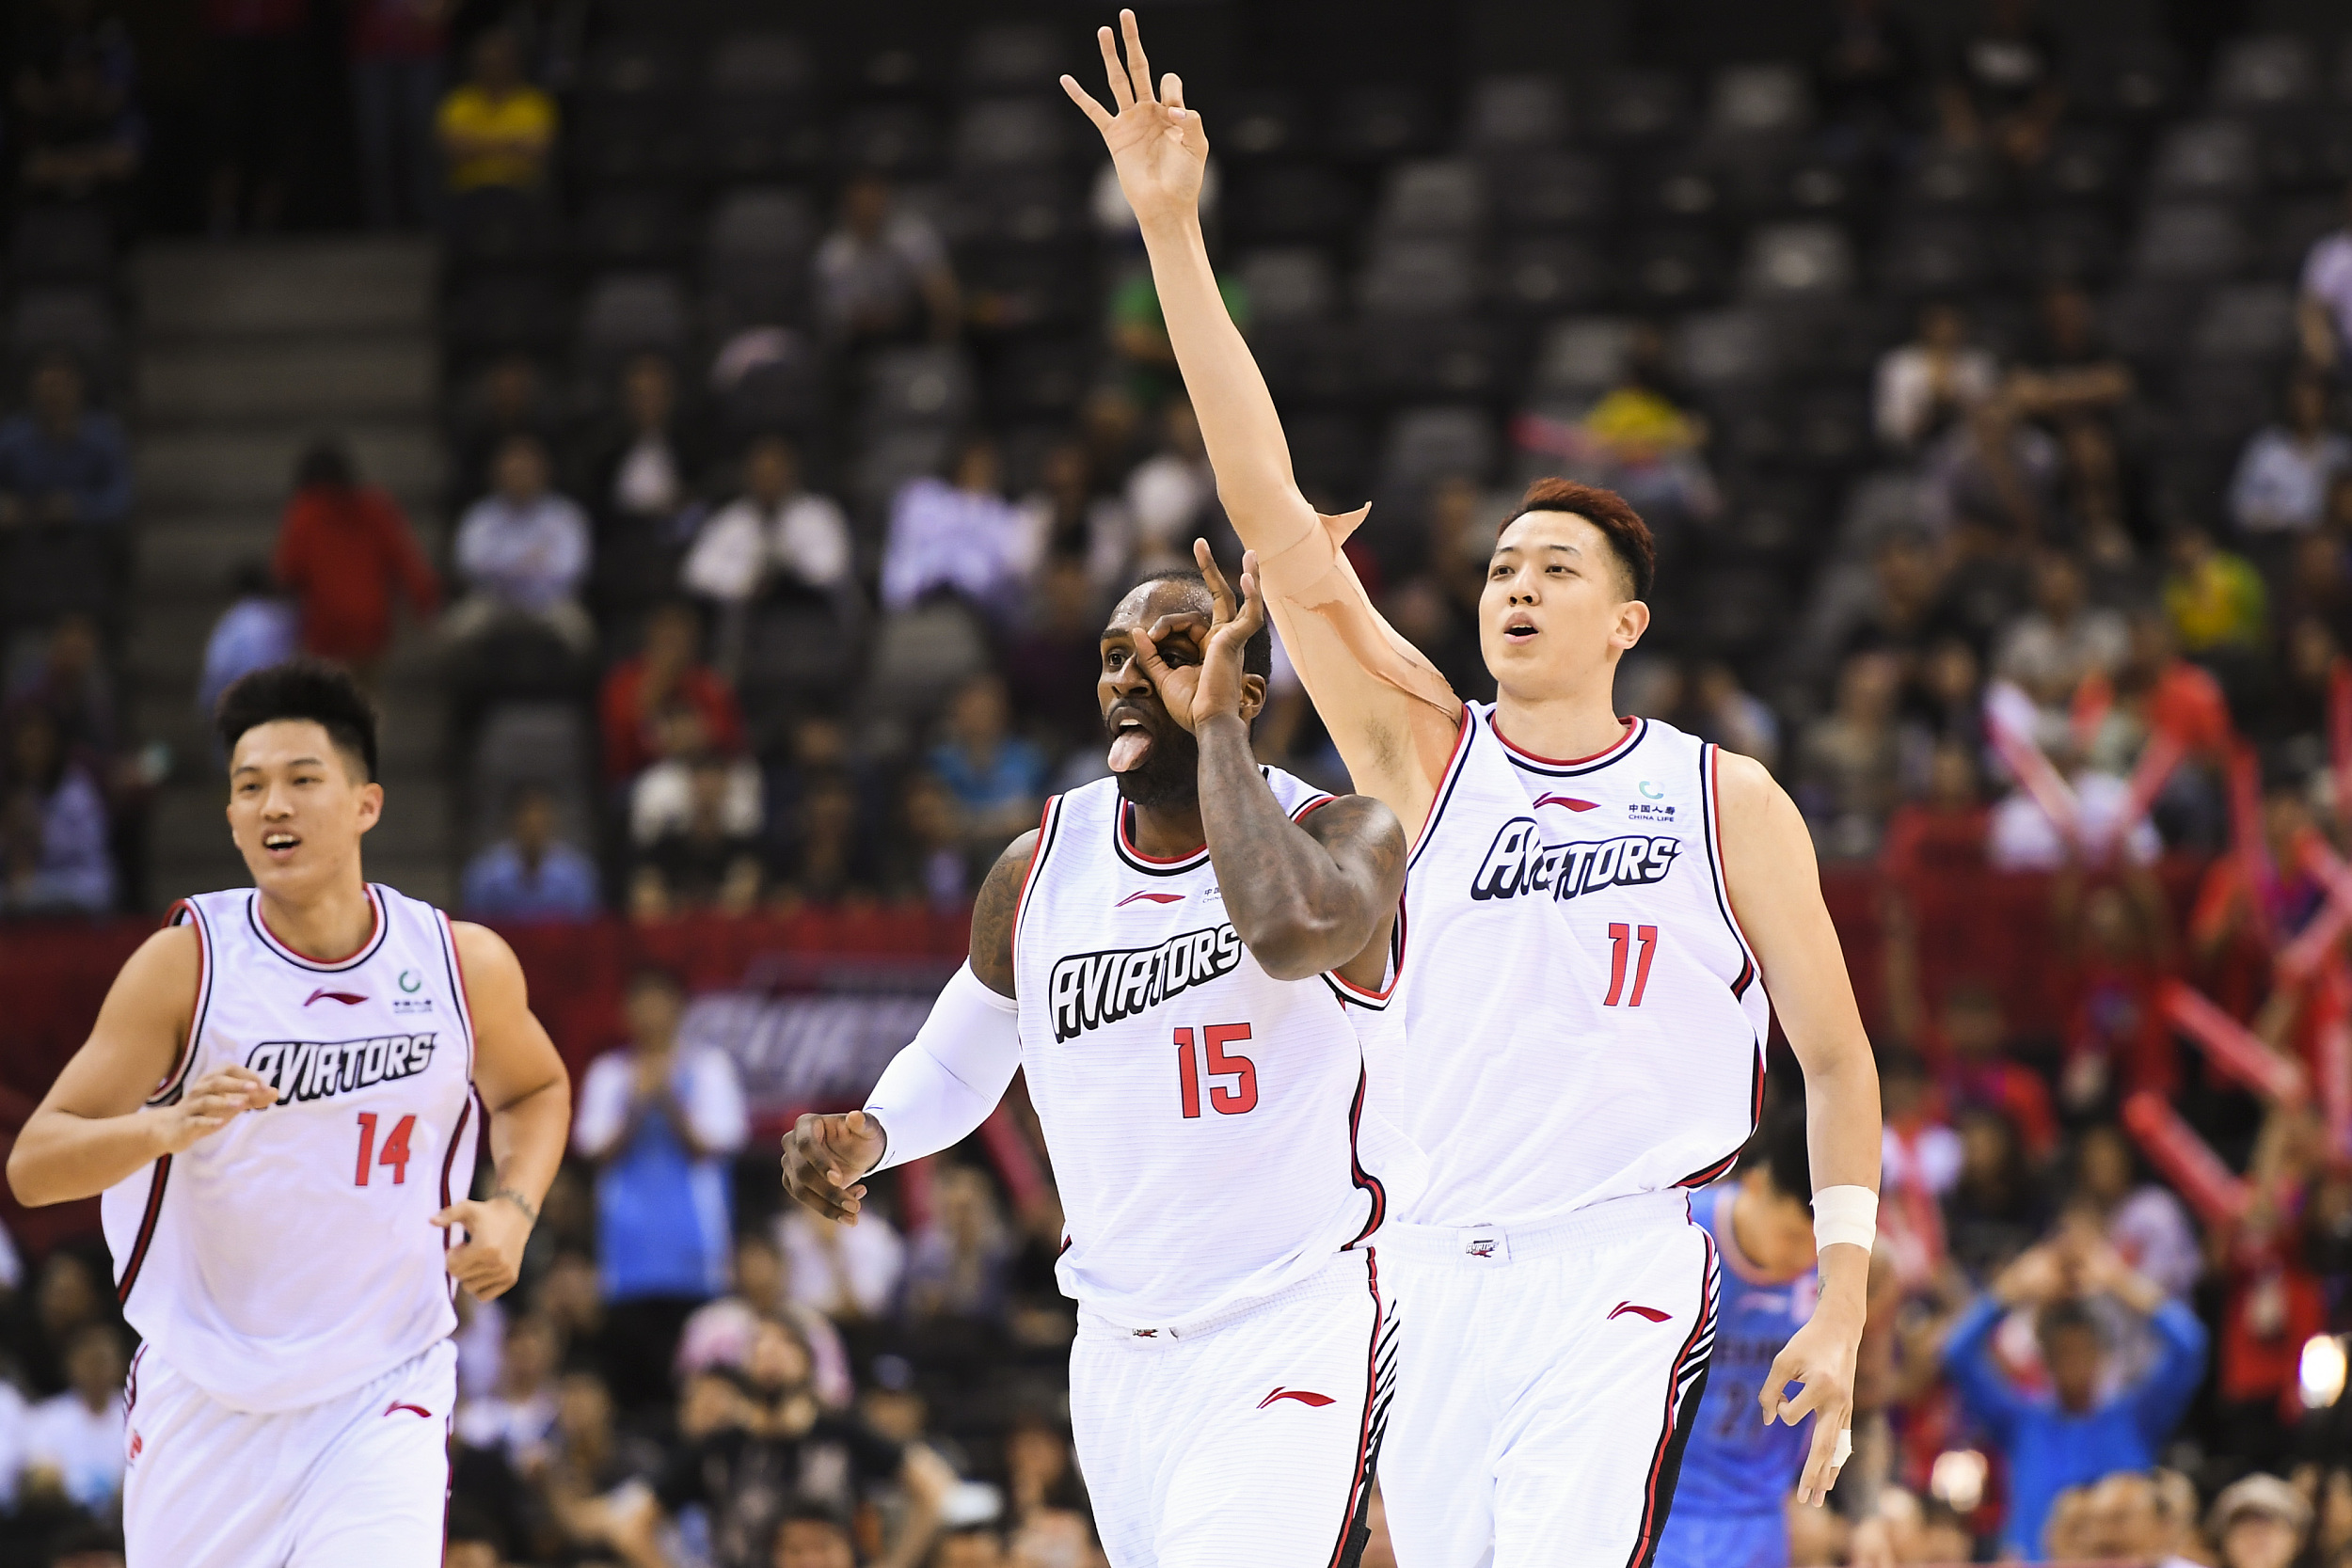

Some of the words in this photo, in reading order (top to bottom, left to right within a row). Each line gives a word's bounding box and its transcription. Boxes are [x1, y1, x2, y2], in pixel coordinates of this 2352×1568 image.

[1049, 922, 1243, 1044] AVIATORS
[1603, 922, 1658, 1007] 11
[1173, 1022, 1259, 1118] 15
[355, 1113, 417, 1186] 14
